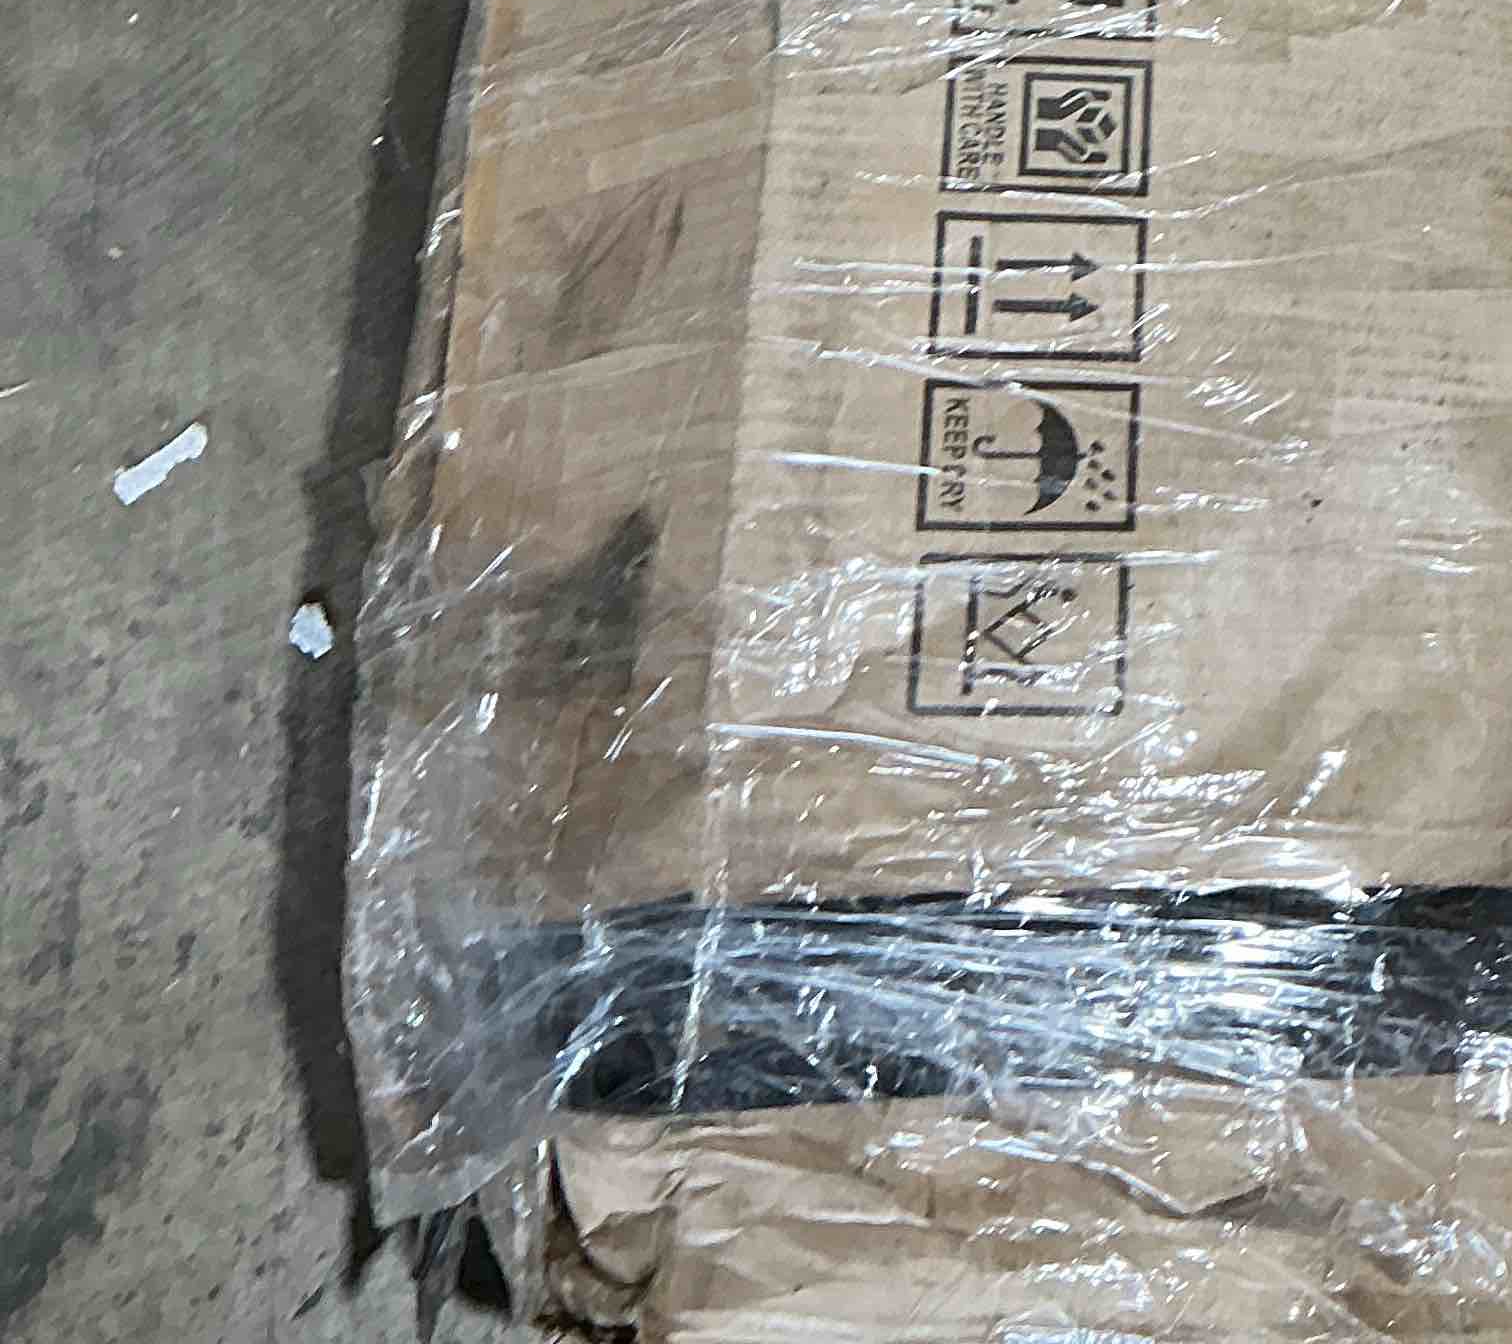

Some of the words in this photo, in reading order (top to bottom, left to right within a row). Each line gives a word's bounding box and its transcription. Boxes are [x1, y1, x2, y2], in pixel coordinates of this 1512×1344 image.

[961, 65, 987, 119] WITH
[958, 123, 982, 178] CARE
[984, 82, 1008, 166] HANDLE
[943, 397, 970, 460] KEEP
